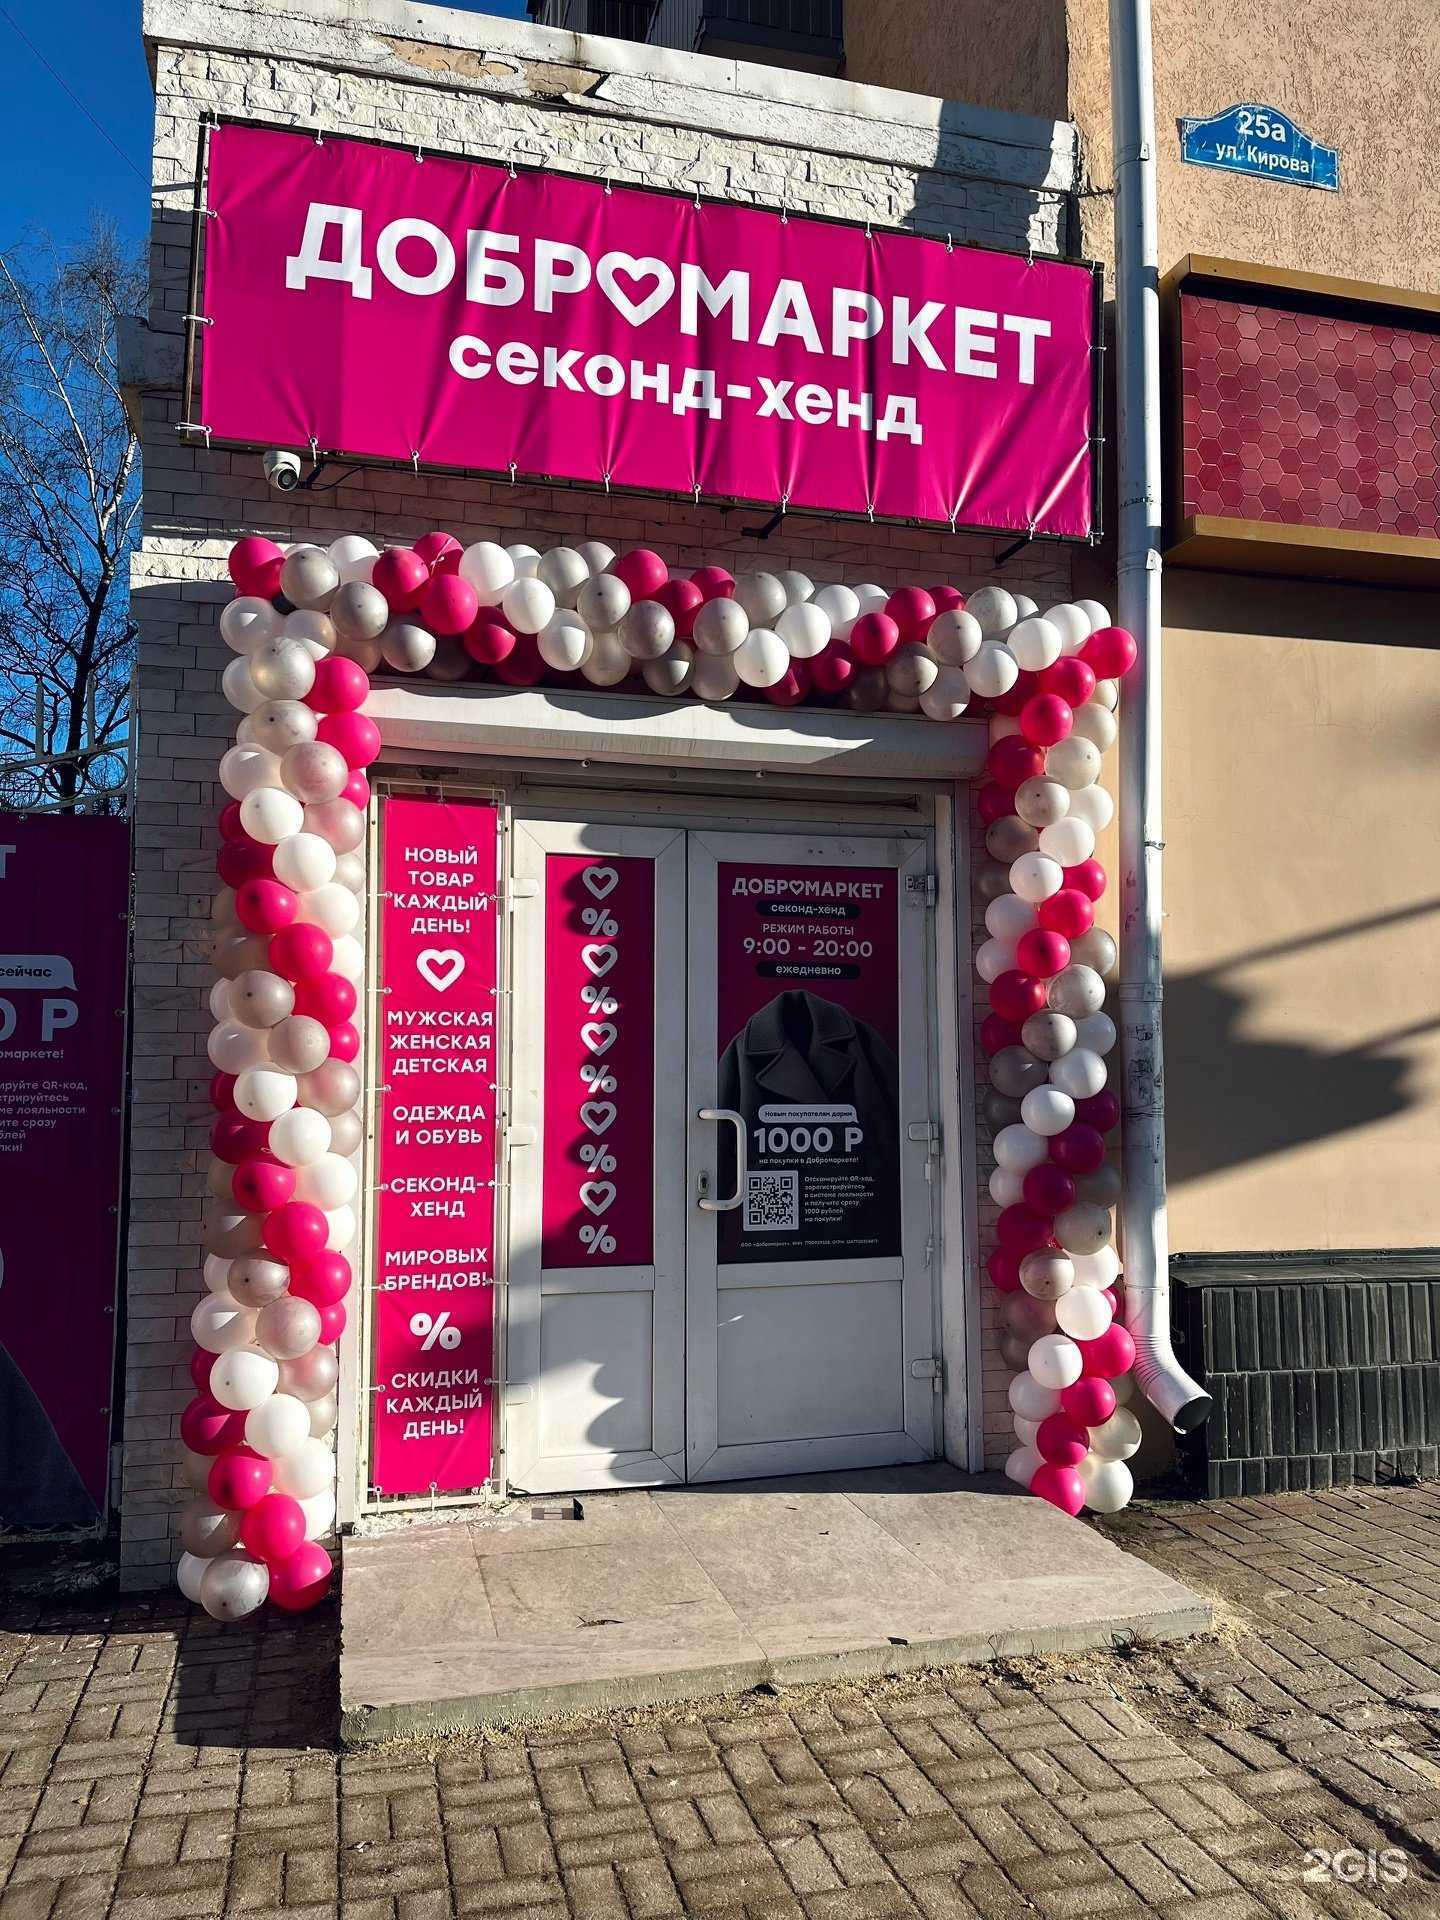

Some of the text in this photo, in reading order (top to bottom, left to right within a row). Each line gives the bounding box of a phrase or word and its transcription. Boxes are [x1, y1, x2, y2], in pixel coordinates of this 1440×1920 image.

[1238, 110, 1286, 143] 25а
[1215, 142, 1309, 173] ул. Кирова
[449, 335, 923, 445] секонд-хенд
[405, 846, 477, 864] НОВЫЙ
[408, 871, 473, 887] ТОВАР
[393, 891, 488, 912] КАЖДЫЙ
[772, 905, 845, 915] секонд-хенд
[411, 918, 469, 934] ДЕНЬ!
[763, 924, 853, 935] РЕЖИМ РАБОТЫ
[744, 938, 790, 954] 9:00
[813, 940, 872, 957] 20:00
[776, 966, 841, 975] ежедневно
[388, 1011, 492, 1025] МУЖСКАЯ
[390, 1035, 490, 1049] ЖЕНСКАЯ
[393, 1059, 486, 1075] ДЕТСКАЯ
[17, 1106, 86, 1114] лояльности
[393, 1105, 485, 1123] ОДЕЖДА
[22, 1119, 57, 1128] сразу
[396, 1129, 482, 1144] И ОБУВЬ
[754, 1127, 833, 1153] 1000
[390, 1176, 484, 1194] СЕКОНД-
[411, 1201, 465, 1218] ХЕНД
[386, 1248, 487, 1266] МИРОВЫХ
[385, 1271, 488, 1292] БРЕНДОВ!
[391, 1369, 479, 1388] СКИДКИ
[387, 1389, 481, 1413] КАЖДЫЙ
[403, 1419, 463, 1440] ДЕНЬ!
